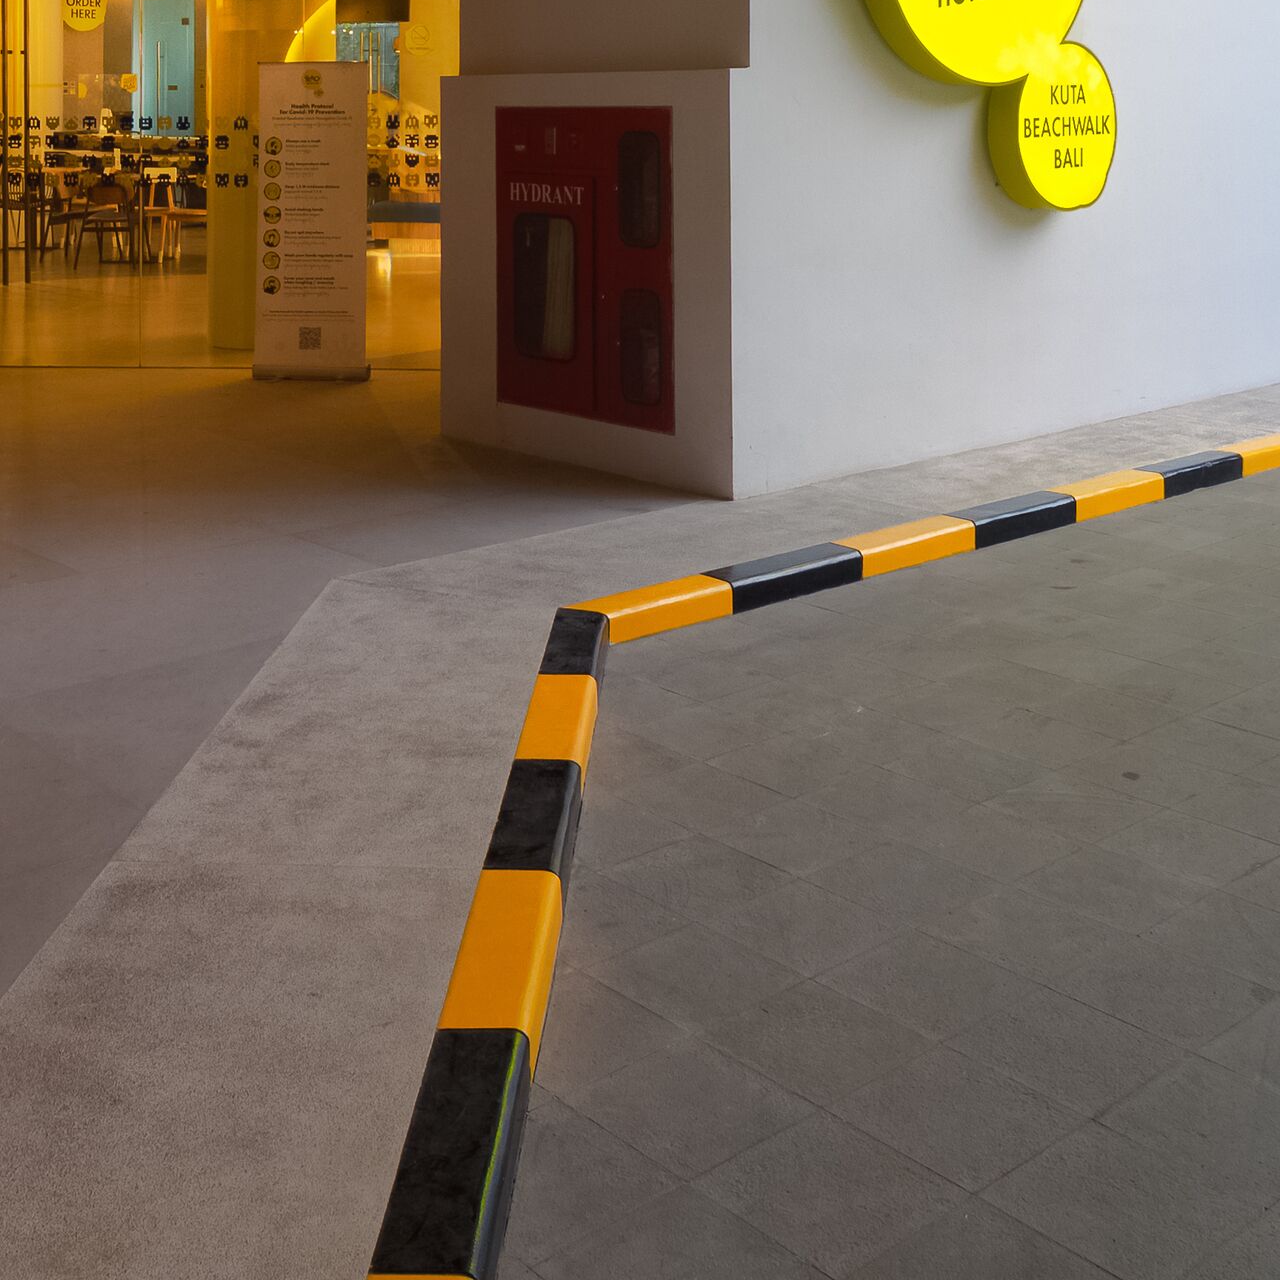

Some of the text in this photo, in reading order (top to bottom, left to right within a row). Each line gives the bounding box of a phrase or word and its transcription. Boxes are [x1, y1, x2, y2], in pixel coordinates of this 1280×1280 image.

[71, 9, 96, 19] HERE
[1049, 83, 1087, 106] KUTA
[1023, 113, 1111, 138] BEACHWALK
[1053, 147, 1084, 170] BALI
[510, 182, 585, 205] HYDRANT
